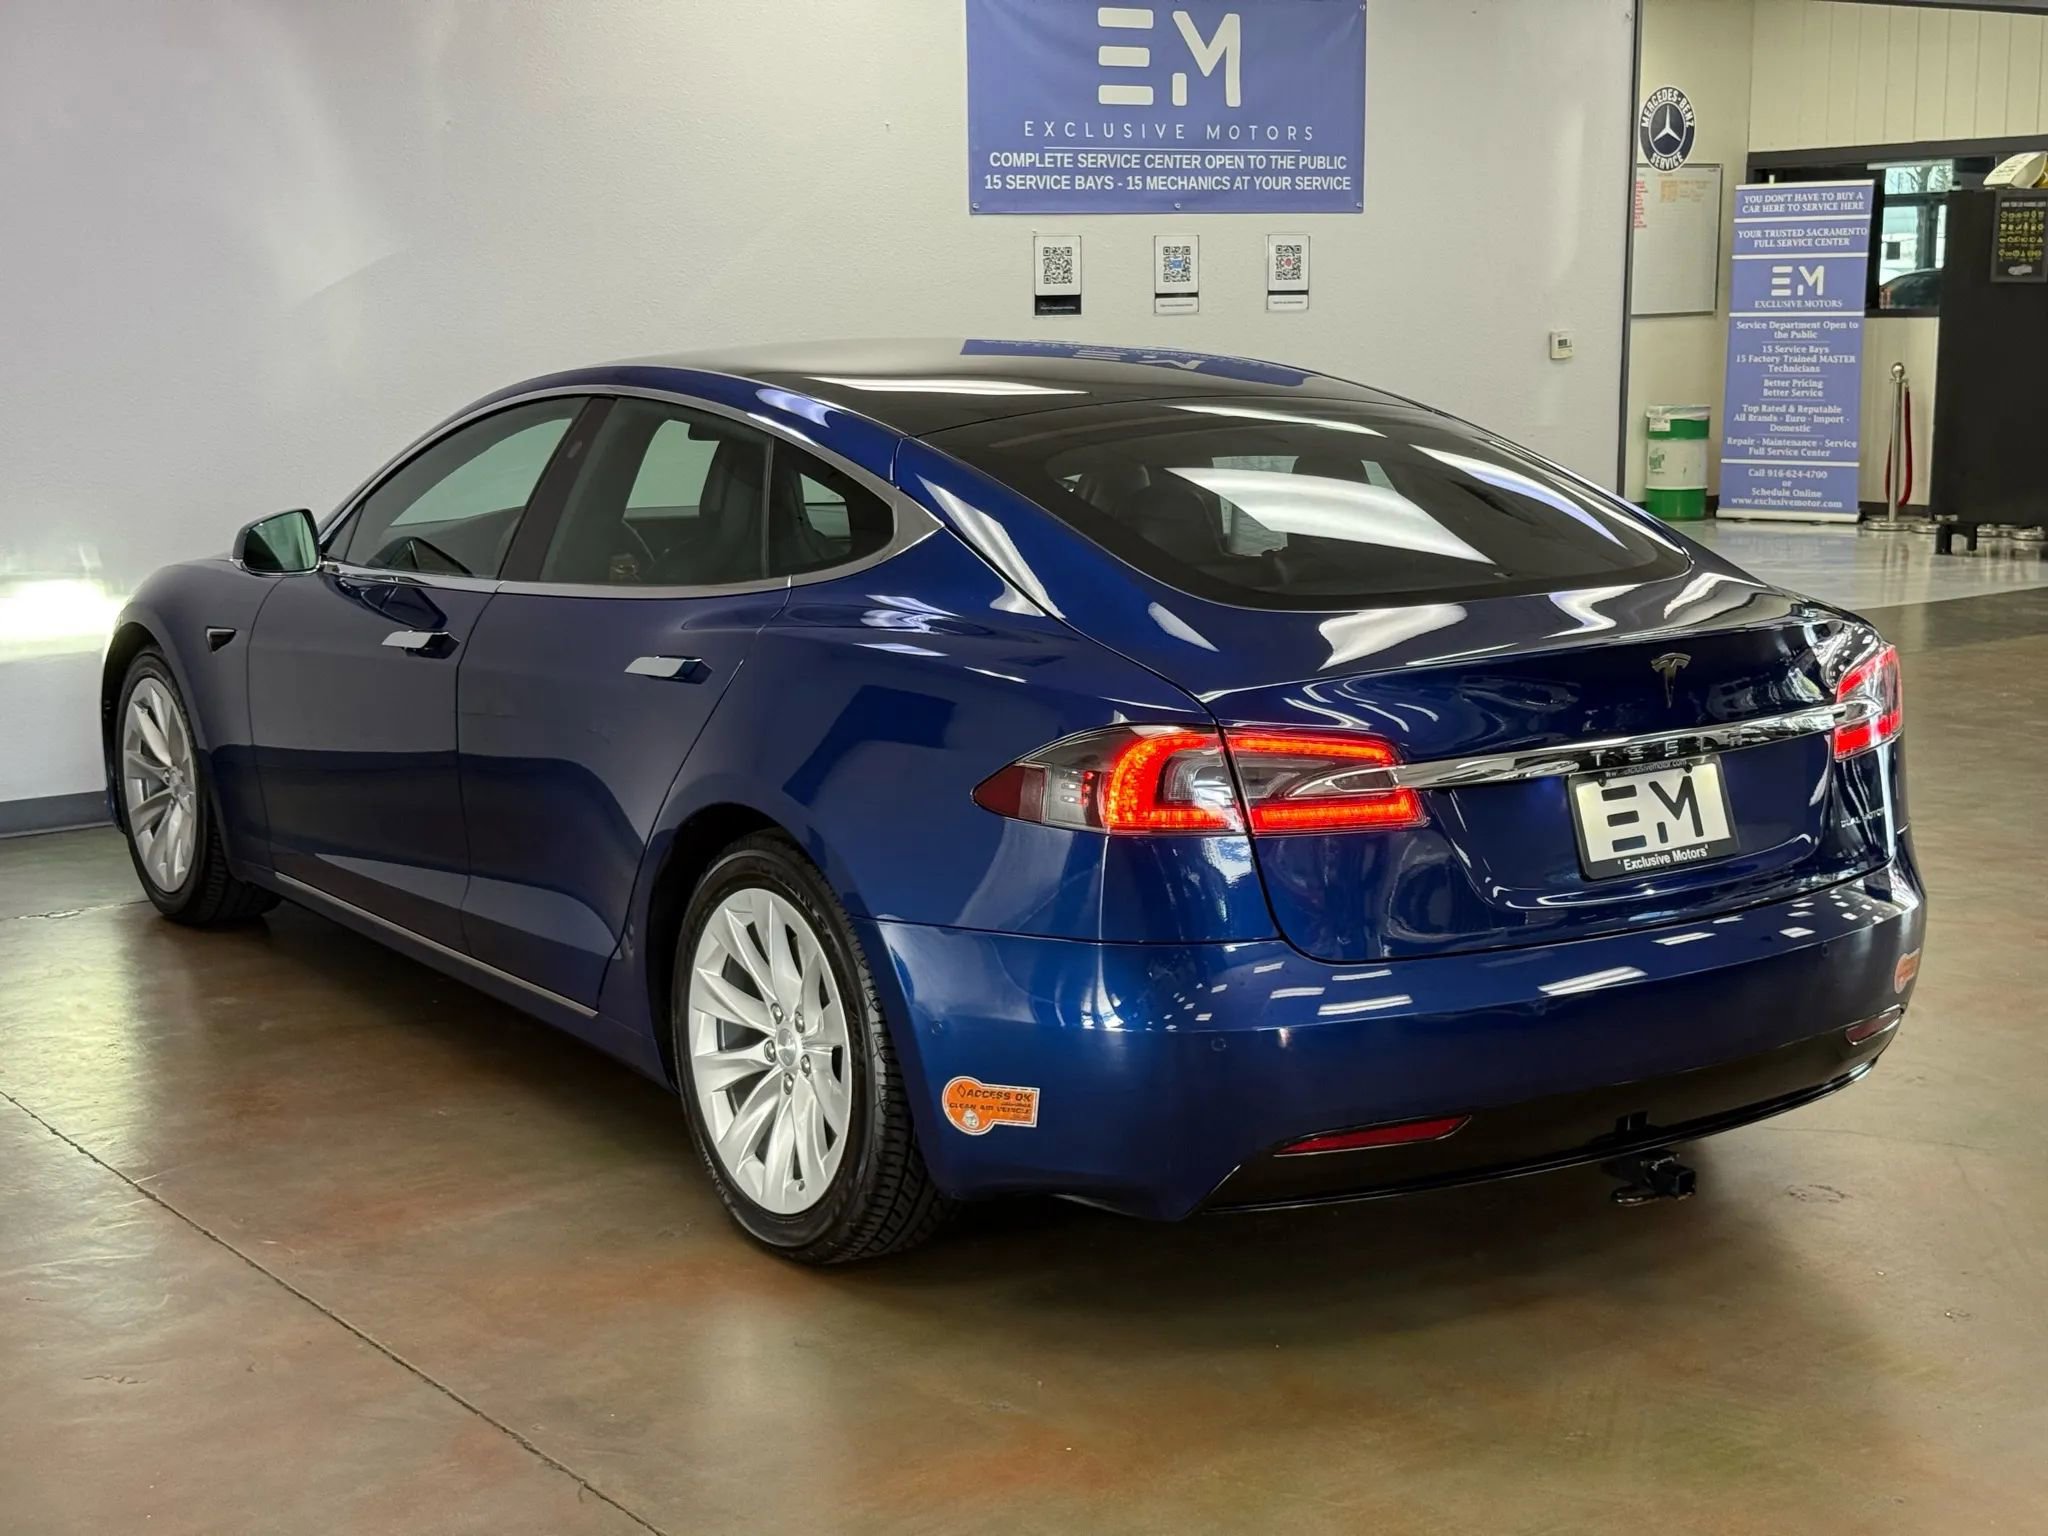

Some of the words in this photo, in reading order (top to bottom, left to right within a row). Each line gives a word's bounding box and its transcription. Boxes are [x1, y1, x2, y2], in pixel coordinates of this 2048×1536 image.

[1098, 7, 1241, 108] EM
[1024, 120, 1185, 140] EXCLUSIVE
[1206, 124, 1313, 141] MOTORS
[989, 151, 1074, 168] COMPLETE
[1077, 153, 1141, 169] SERVICE
[1144, 153, 1201, 169] CENTER
[1204, 154, 1245, 169] OPEN
[1247, 155, 1267, 170] TO
[1270, 155, 1296, 170] THE
[1298, 155, 1347, 170] PUBLIC
[1650, 152, 1684, 170] SERVICE
[984, 174, 1001, 190] 15
[1005, 174, 1071, 190] SERVICE
[1074, 175, 1114, 190] BAYS
[1126, 175, 1143, 191] 15
[1146, 175, 1231, 191] MECHANICS
[1233, 175, 1251, 190] AT
[1253, 176, 1292, 191] YOUR
[1295, 176, 1352, 191] SERVICE
[1744, 195, 1764, 204] YOU
[1764, 194, 1793, 204] DON'T
[1794, 193, 1820, 202] HAVE
[1821, 192, 1835, 201] TO
[1836, 192, 1856, 201] BUY
[1856, 191, 1863, 200] A
[1742, 204, 1760, 214] CAR
[1762, 203, 1785, 213] HERE
[1787, 203, 1800, 212] TO
[1802, 202, 1839, 211] SERVICE
[1840, 201, 1865, 210] HERE
[1738, 230, 1762, 239] YOUR
[1764, 229, 1805, 238] TRUSTED
[1806, 227, 1868, 237] SACRAMENTO
[1754, 239, 1775, 248] FULL
[1776, 238, 1813, 247] SERVICE
[1814, 237, 1851, 247] CENTER
[1771, 265, 1825, 297] EM
[1754, 300, 1802, 309] EXCLUSIVE
[1803, 299, 1842, 308] MOTORS
[1736, 321, 1767, 329] Service
[1769, 321, 1821, 331] Department
[1823, 320, 1847, 331] Open
[1849, 321, 1859, 329] to
[1774, 331, 1788, 339] the
[1790, 331, 1818, 339] Public
[1762, 345, 1773, 353] 15
[1775, 345, 1807, 353] Service
[1808, 345, 1829, 355] Bays
[1736, 355, 1746, 363] 15
[1748, 355, 1780, 364] Factory
[1784, 355, 1817, 363] Trained
[1819, 355, 1856, 363] MASTER
[1768, 364, 1821, 372] Technicians
[1763, 379, 1789, 387] Better
[1791, 379, 1824, 389] Pricing
[1763, 388, 1790, 397] Better
[1791, 388, 1823, 397] Service
[1742, 404, 1759, 413] Top
[1761, 404, 1786, 412] Rated
[1797, 405, 1842, 414] Reputable
[1733, 414, 1746, 422] All
[1748, 414, 1778, 422] Brands
[1785, 415, 1806, 423] Euro
[1813, 415, 1844, 424] Import
[1770, 424, 1811, 433] Domestic
[1727, 437, 1755, 446] Repair
[1762, 438, 1817, 447] Maintenance
[1824, 439, 1857, 448] Service
[1748, 447, 1765, 455] Full
[1767, 447, 1799, 456] Service
[1801, 448, 1831, 457] Center
[1748, 468, 1765, 477] Call
[1751, 488, 1790, 497] Schedule
[1792, 489, 1823, 498] Online
[1601, 775, 1705, 853] EM
[966, 1089, 1011, 1100] ACCESS
[1015, 1093, 1033, 1102] OK
[997, 1106, 1032, 1114] VEHICLE
